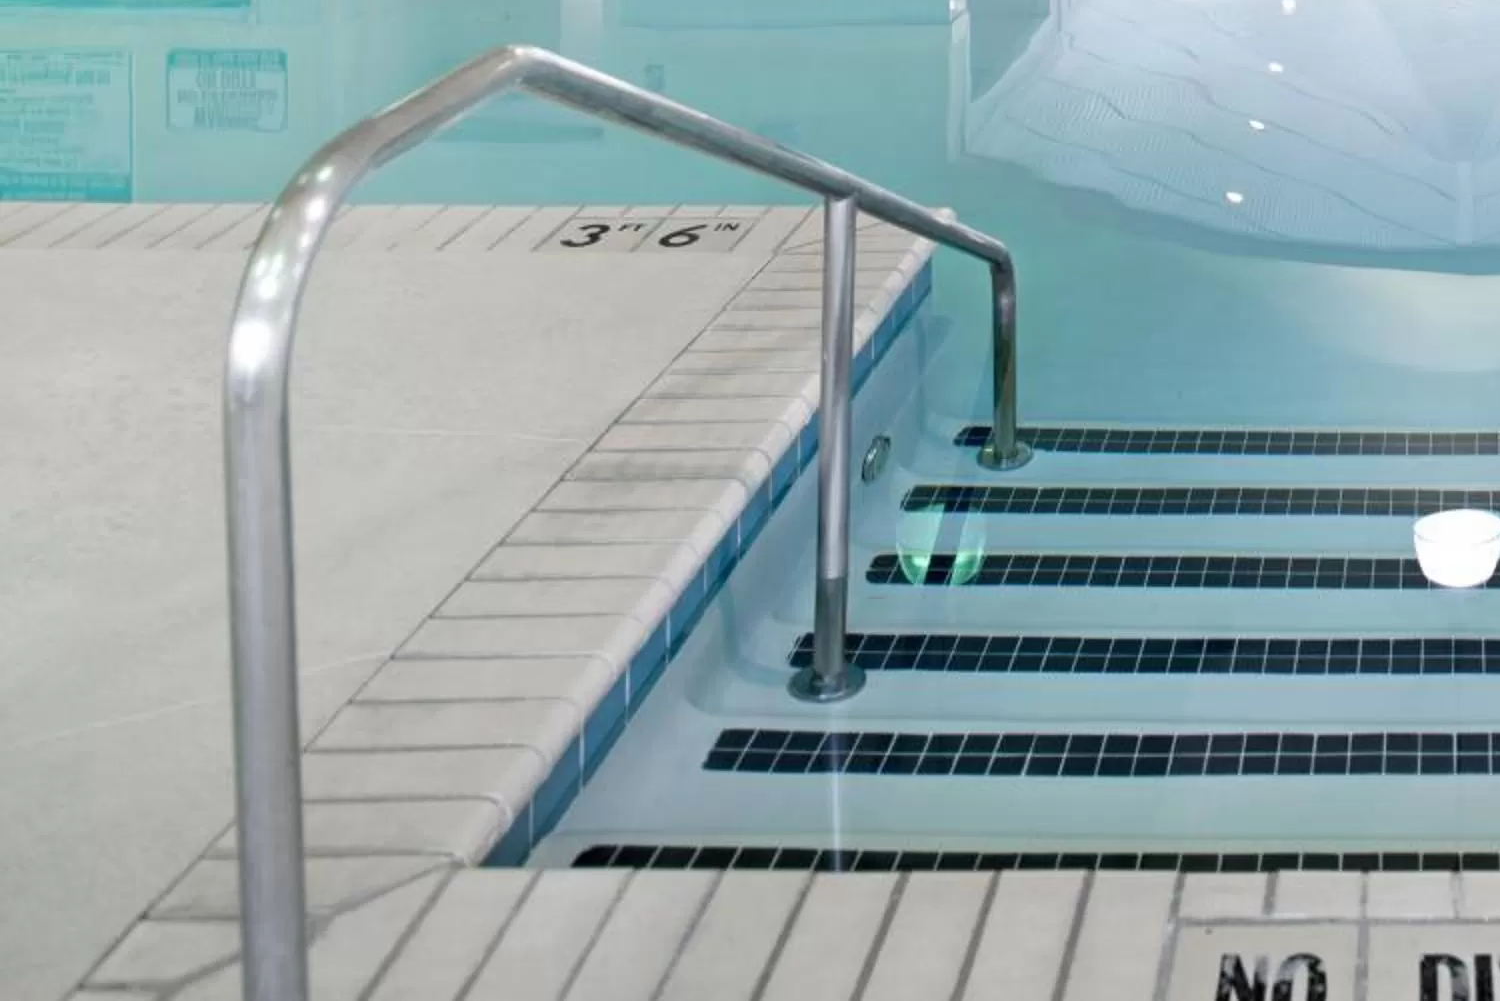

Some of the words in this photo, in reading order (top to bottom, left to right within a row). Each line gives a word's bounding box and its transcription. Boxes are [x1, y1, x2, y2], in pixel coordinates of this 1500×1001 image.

[560, 223, 611, 247] 3
[618, 223, 645, 232] FT
[658, 224, 709, 247] 6
[714, 222, 741, 232] IN
[1214, 952, 1328, 1001] NO
